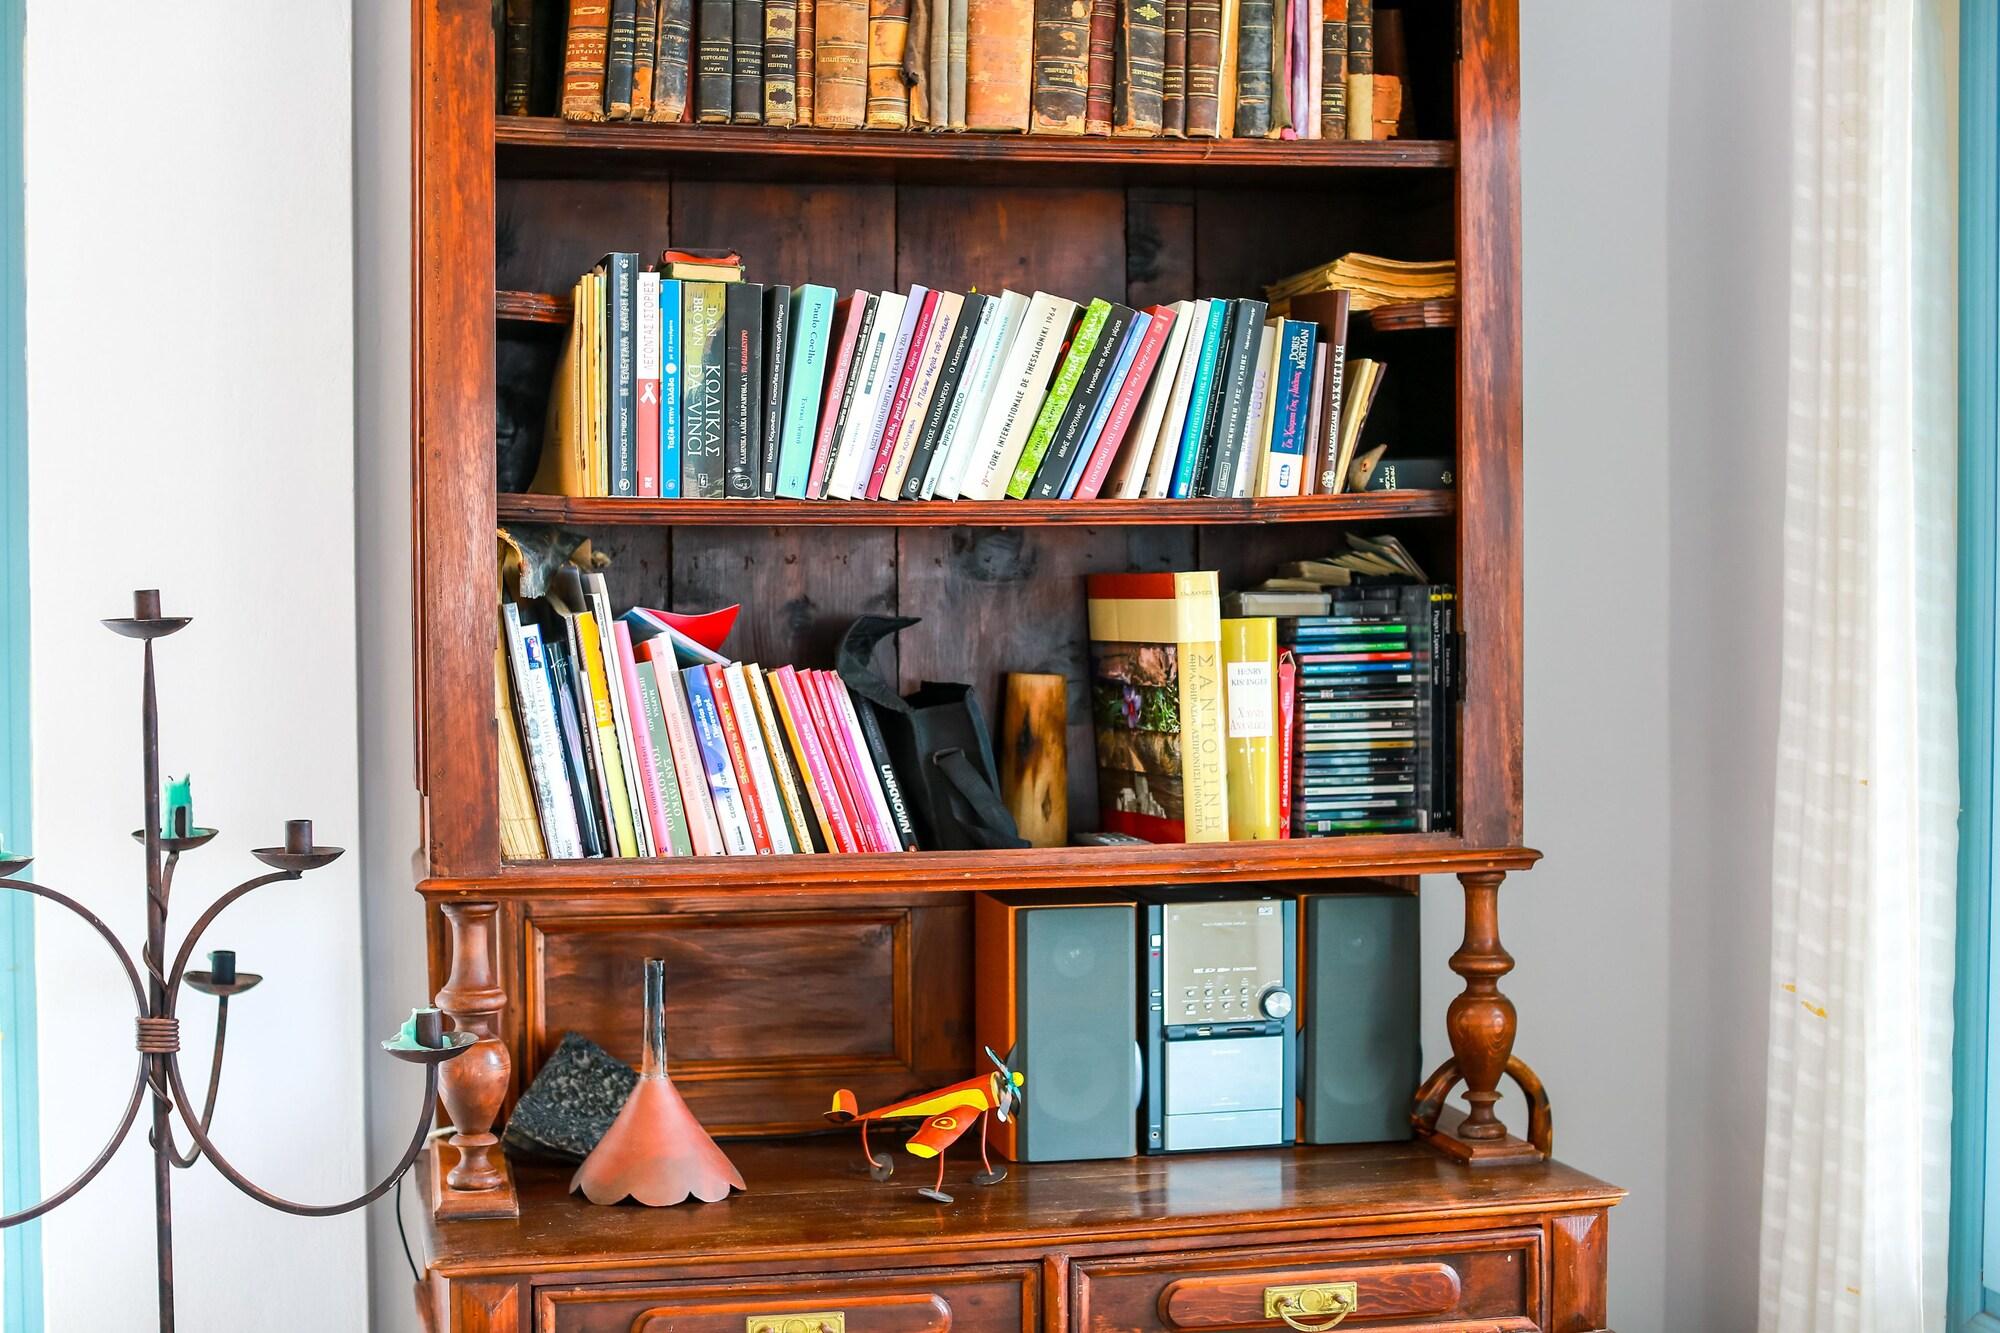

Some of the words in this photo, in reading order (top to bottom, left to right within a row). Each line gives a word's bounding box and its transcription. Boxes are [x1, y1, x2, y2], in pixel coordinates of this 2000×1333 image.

[619, 271, 629, 297] ΓΑΤΑ
[642, 280, 654, 321] ΙΣΤΟΡΙΕΣ
[619, 297, 629, 331] ΜΑΥΡΗ
[692, 297, 703, 346] BROWN
[705, 306, 718, 337] DAN
[810, 302, 822, 329] Paulo
[1044, 305, 1057, 324] 1964
[642, 322, 654, 369] ΛΕΓΟΝΤΑΣ
[774, 332, 783, 352] νεαρή
[805, 330, 819, 365] Coelho
[1023, 324, 1050, 376] THESSALONIKI
[1287, 334, 1302, 361] DORIS
[1296, 327, 1310, 369] MORTMAN
[619, 335, 629, 385] ΤΕΛΕΥΤΑΙΑ
[687, 363, 702, 389] DA
[740, 365, 747, 373] ΤΟ
[774, 363, 780, 372] σε
[947, 366, 956, 374] Ο
[1084, 386, 1092, 394] Η
[1097, 356, 1106, 368] της
[1235, 353, 1247, 386] ΑΓΑΠΗΣ
[1330, 343, 1344, 408] ΑΣΚΗΤΙΚΗ
[619, 387, 629, 397] Η
[666, 376, 675, 404] Ελλάδα
[868, 428, 881, 451] ΚΩΣΤΗ
[887, 373, 896, 384] ΤΑ
[898, 331, 909, 347] ΖΩΑ
[1019, 376, 1029, 388] DE
[1232, 387, 1242, 405] ΤΗΣ
[1250, 369, 1266, 420] ZORBA
[667, 406, 675, 424] στην
[704, 363, 720, 457] ΚΩΔΙΚΑΣ
[929, 379, 952, 428] ΠΑΠΑΝΔΡΕΟΥ
[940, 422, 955, 447] PIPPO
[948, 391, 966, 423] FRANCO
[996, 389, 1025, 448] INTERNATIONALE
[686, 399, 702, 456] VINCI
[922, 427, 937, 451] ΝΙΚΟΣ
[1104, 431, 1116, 447] ΤΟΥ
[1224, 406, 1238, 448] ΑΣΚΗΤΙΚΗ
[1327, 409, 1338, 452] ΚΑΖΑΝΤΖΑΚΗ
[619, 437, 628, 471] ΕΥΓΕΝΙΟΣ
[739, 434, 747, 464] ΕΛΛΗΝΙΚΑ
[987, 449, 1001, 471] FOIRE
[1188, 653, 1197, 682] ΘΗΡΑ,
[638, 676, 655, 733] ΠΕΤΡΟΠΟΥΛΟΥ
[647, 688, 660, 718] ΜΑΡΙΝΑ
[650, 744, 663, 769] ΤΟΥ
[1197, 653, 1221, 832] ΣΑΝΤΟΡΙΝΗ
[661, 757, 675, 780] ΣΑΝ
[1281, 758, 1289, 795] COLORED
[655, 770, 675, 832] ΚΟΥΤΑΛΙΟΥ
[666, 780, 682, 817] ΓΛΥΚΟ
[724, 793, 737, 819] GEORGE
[877, 762, 914, 836] UNKNOWN
